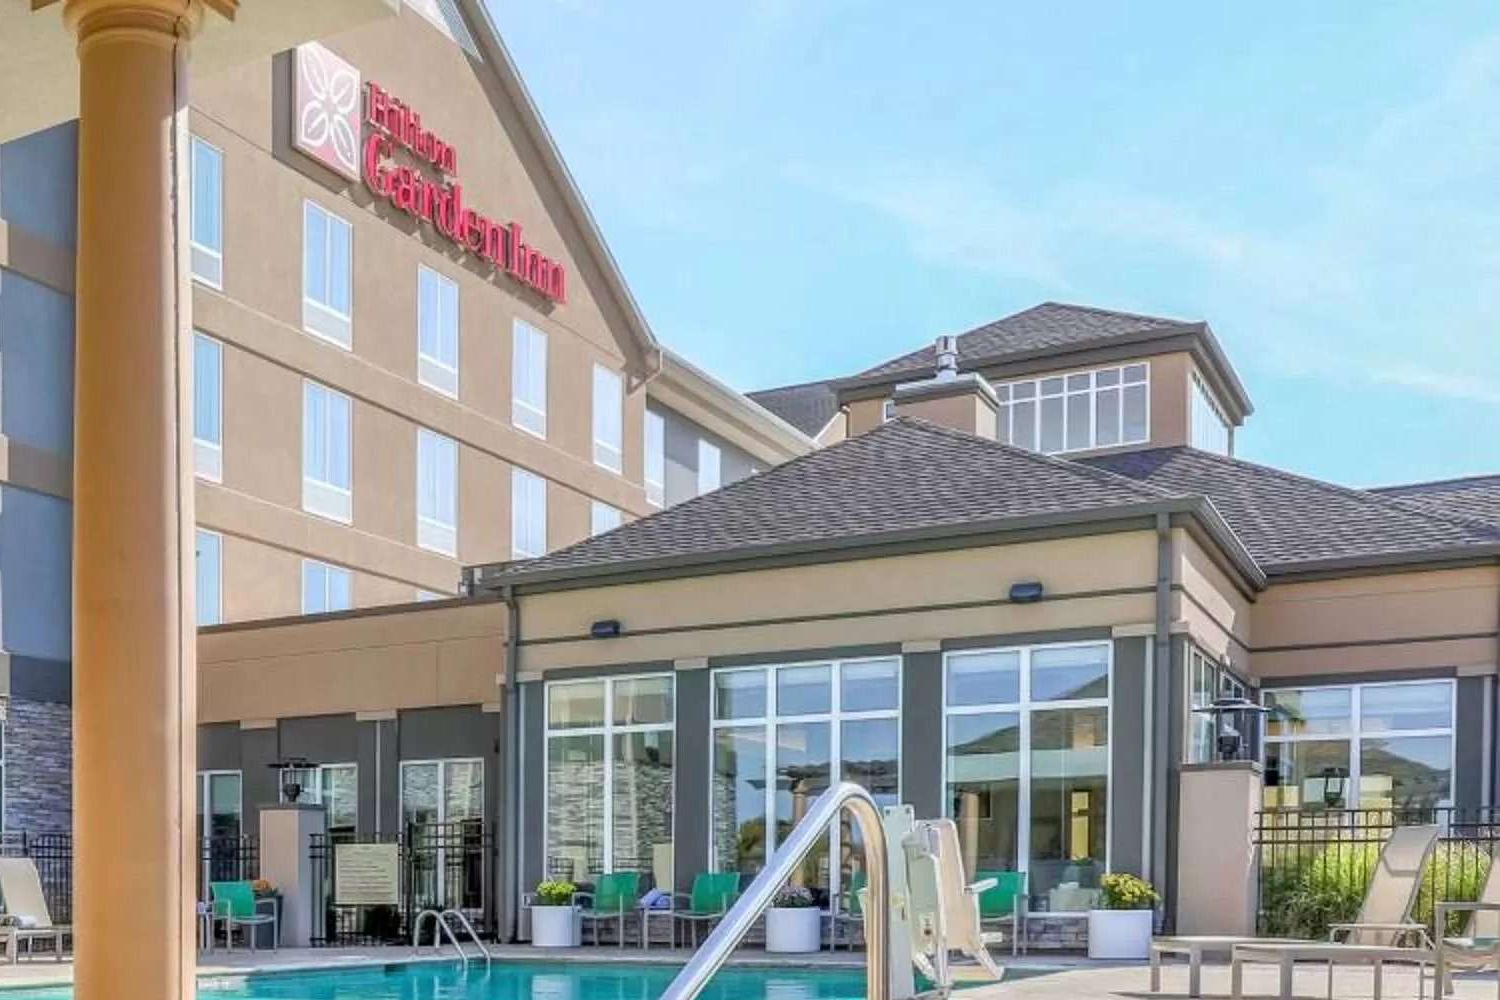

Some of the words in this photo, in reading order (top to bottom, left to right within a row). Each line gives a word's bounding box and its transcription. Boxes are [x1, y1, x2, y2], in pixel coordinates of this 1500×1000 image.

[366, 80, 457, 176] Hilton
[364, 132, 505, 269] Garden
[509, 222, 566, 302] Inn
